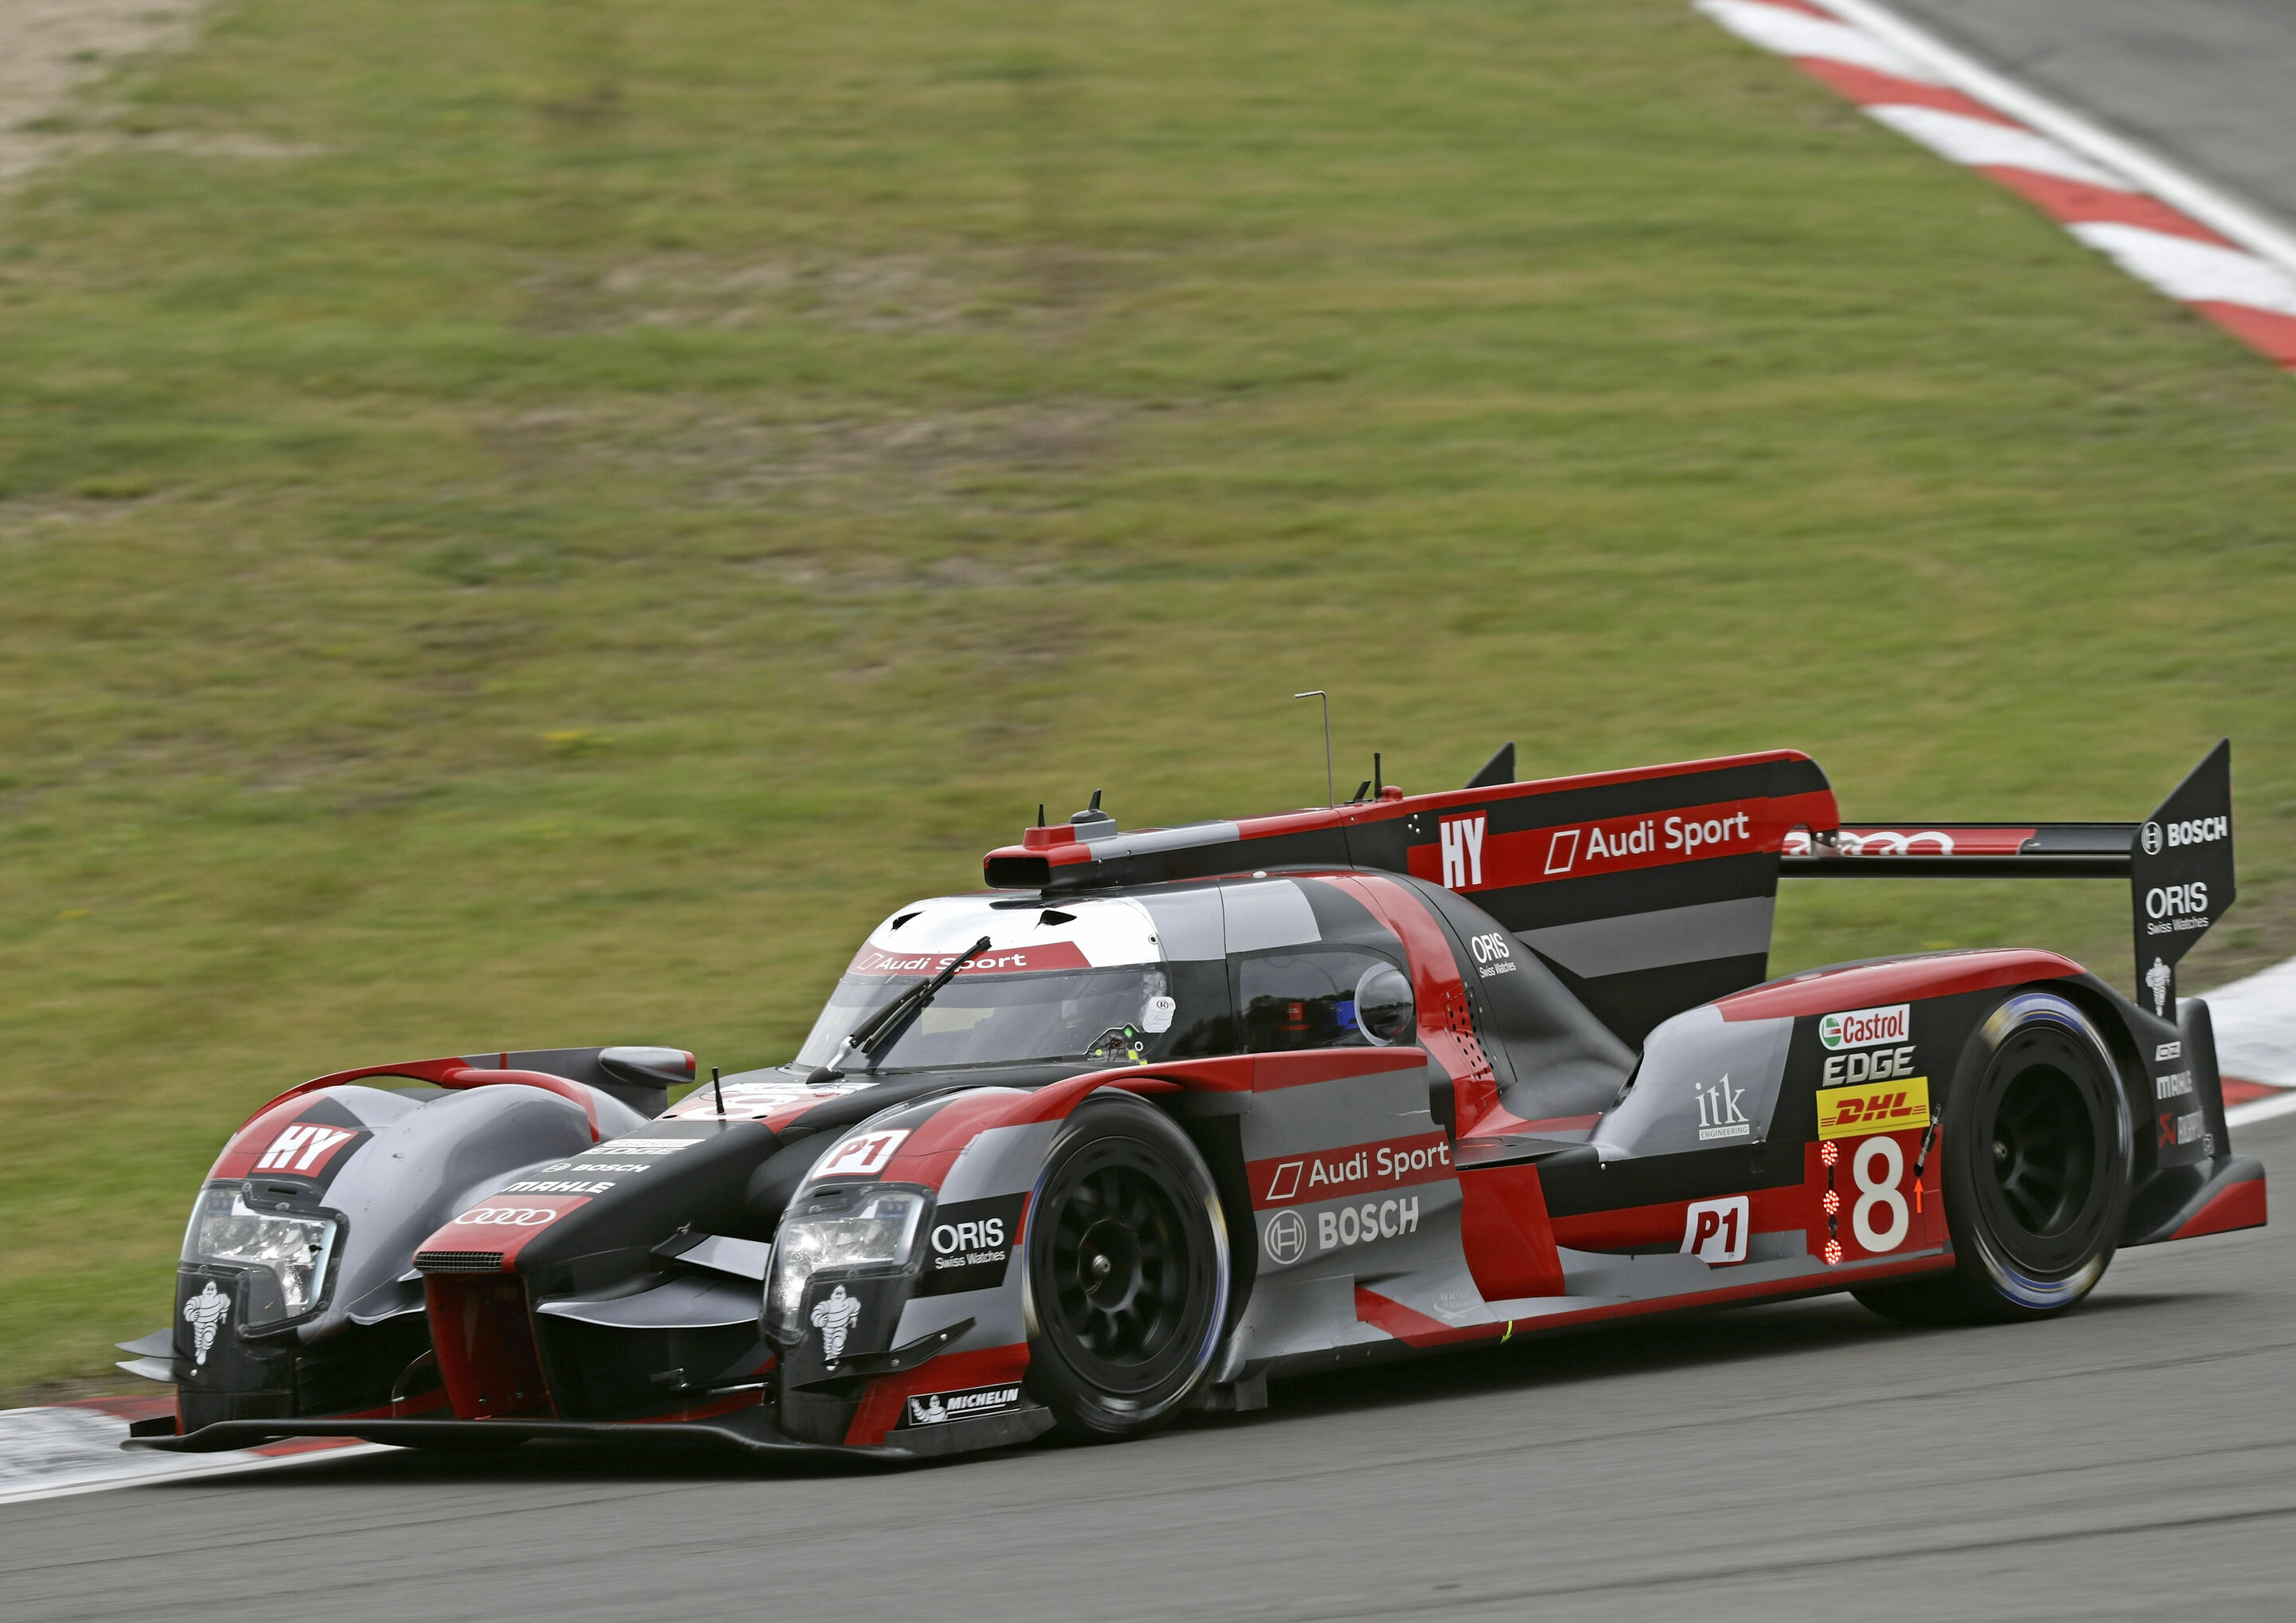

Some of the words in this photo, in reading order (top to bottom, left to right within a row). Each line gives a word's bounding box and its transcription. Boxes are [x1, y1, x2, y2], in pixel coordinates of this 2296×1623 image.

[1586, 820, 1655, 860] Audi
[1665, 812, 1750, 855] Sport
[2168, 816, 2227, 847] BOSCH
[1441, 816, 1485, 890] HY
[2146, 882, 2208, 918] ORIS
[2147, 922, 2172, 935] Swiss
[2172, 917, 2209, 931] Watches
[875, 957, 931, 970] Audi
[1472, 933, 1509, 963] ORIS
[1480, 965, 1496, 978] Swiss
[1493, 961, 1516, 974] Watches
[1843, 1010, 1904, 1043] Castrol
[1822, 1046, 1917, 1087] EDGE
[1695, 1073, 1749, 1127] itk
[1835, 1092, 1917, 1125] DHL
[258, 1126, 352, 1171] HY
[1700, 1127, 1748, 1139] ENGINEERING
[571, 1164, 651, 1173] BOSCH
[828, 1136, 892, 1169] P1
[1308, 1151, 1368, 1187] Audi
[1377, 1141, 1449, 1181] Sport
[501, 1181, 616, 1194] MAHLE
[1853, 1136, 1909, 1252] 8
[931, 1218, 1005, 1254] ORIS
[1319, 1196, 1419, 1249] BOSCH
[1691, 1208, 1739, 1254] P1
[935, 1256, 965, 1270] Swiss
[966, 1250, 1005, 1265] Watches
[946, 1388, 1019, 1410] MICHELIN
